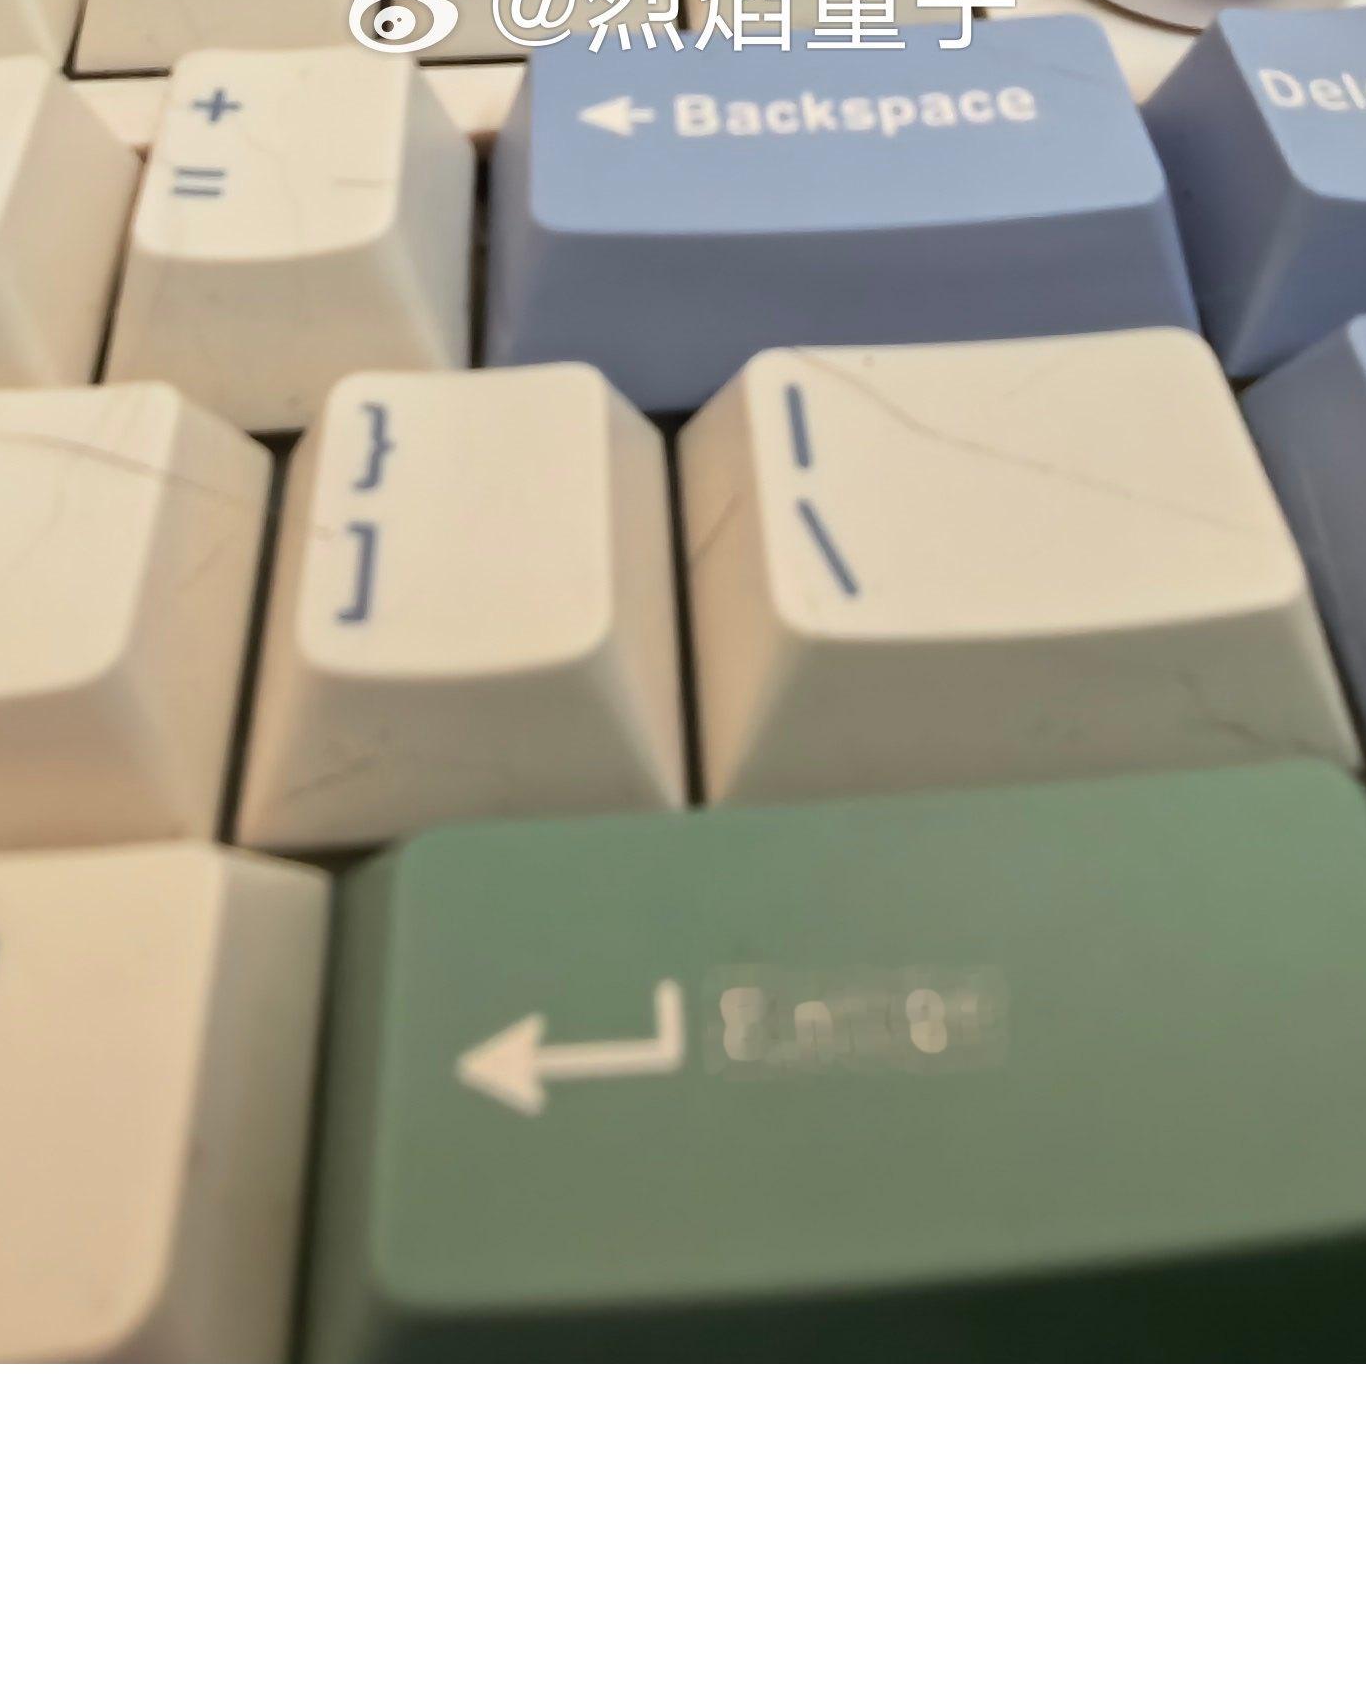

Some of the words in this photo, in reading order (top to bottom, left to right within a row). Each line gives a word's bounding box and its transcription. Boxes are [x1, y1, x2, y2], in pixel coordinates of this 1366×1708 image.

[193, 88, 241, 123] +
[674, 86, 1036, 138] Backspace
[352, 402, 395, 491] }
[333, 522, 378, 624] ]
